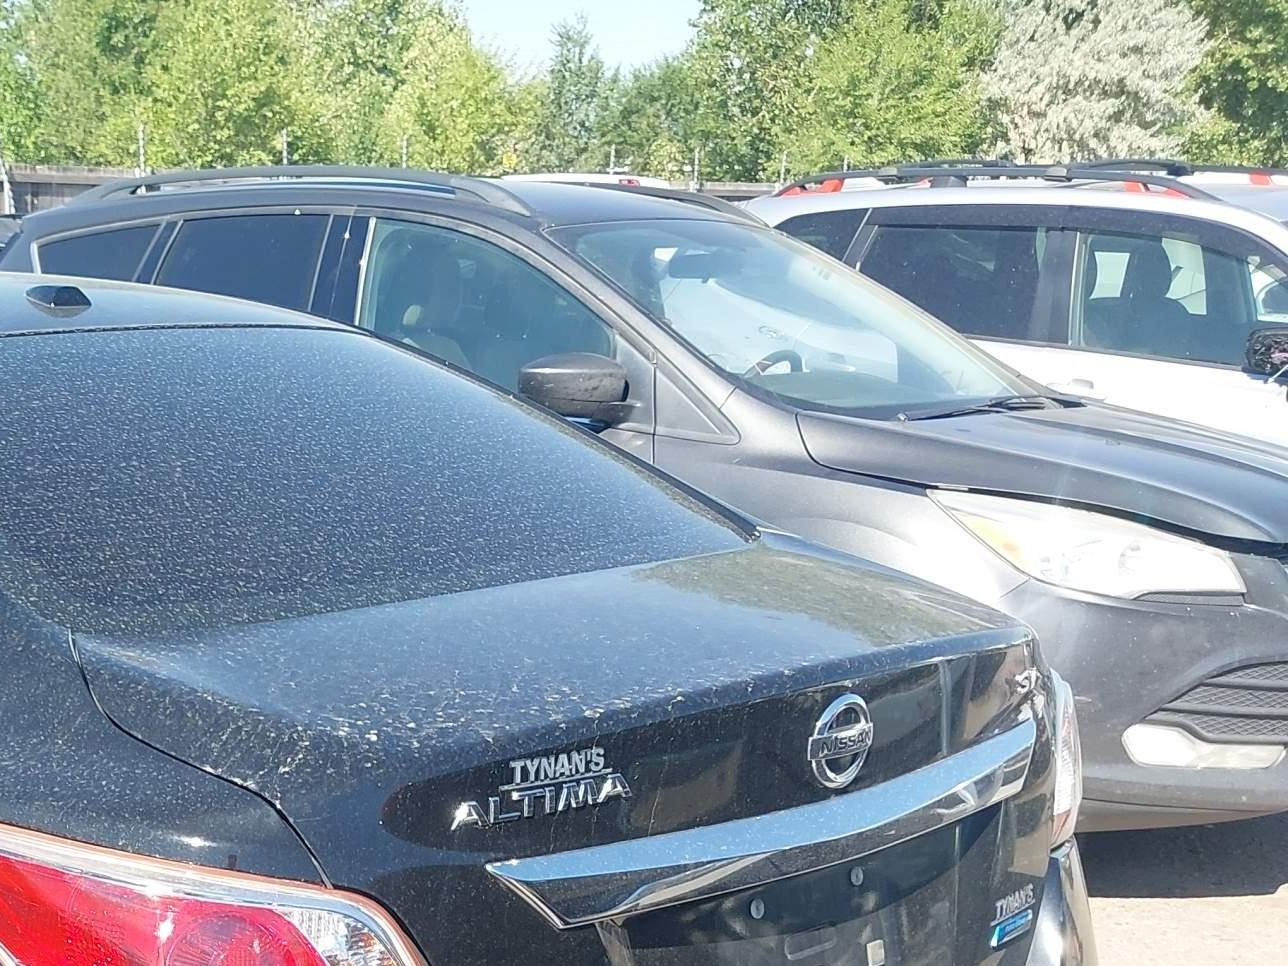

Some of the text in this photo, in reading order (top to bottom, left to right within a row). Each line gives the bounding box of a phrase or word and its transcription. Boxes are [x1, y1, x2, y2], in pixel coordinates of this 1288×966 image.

[820, 728, 872, 753] NISSAN
[509, 747, 605, 785] TYNAN'S
[450, 772, 633, 831] ALTIMA
